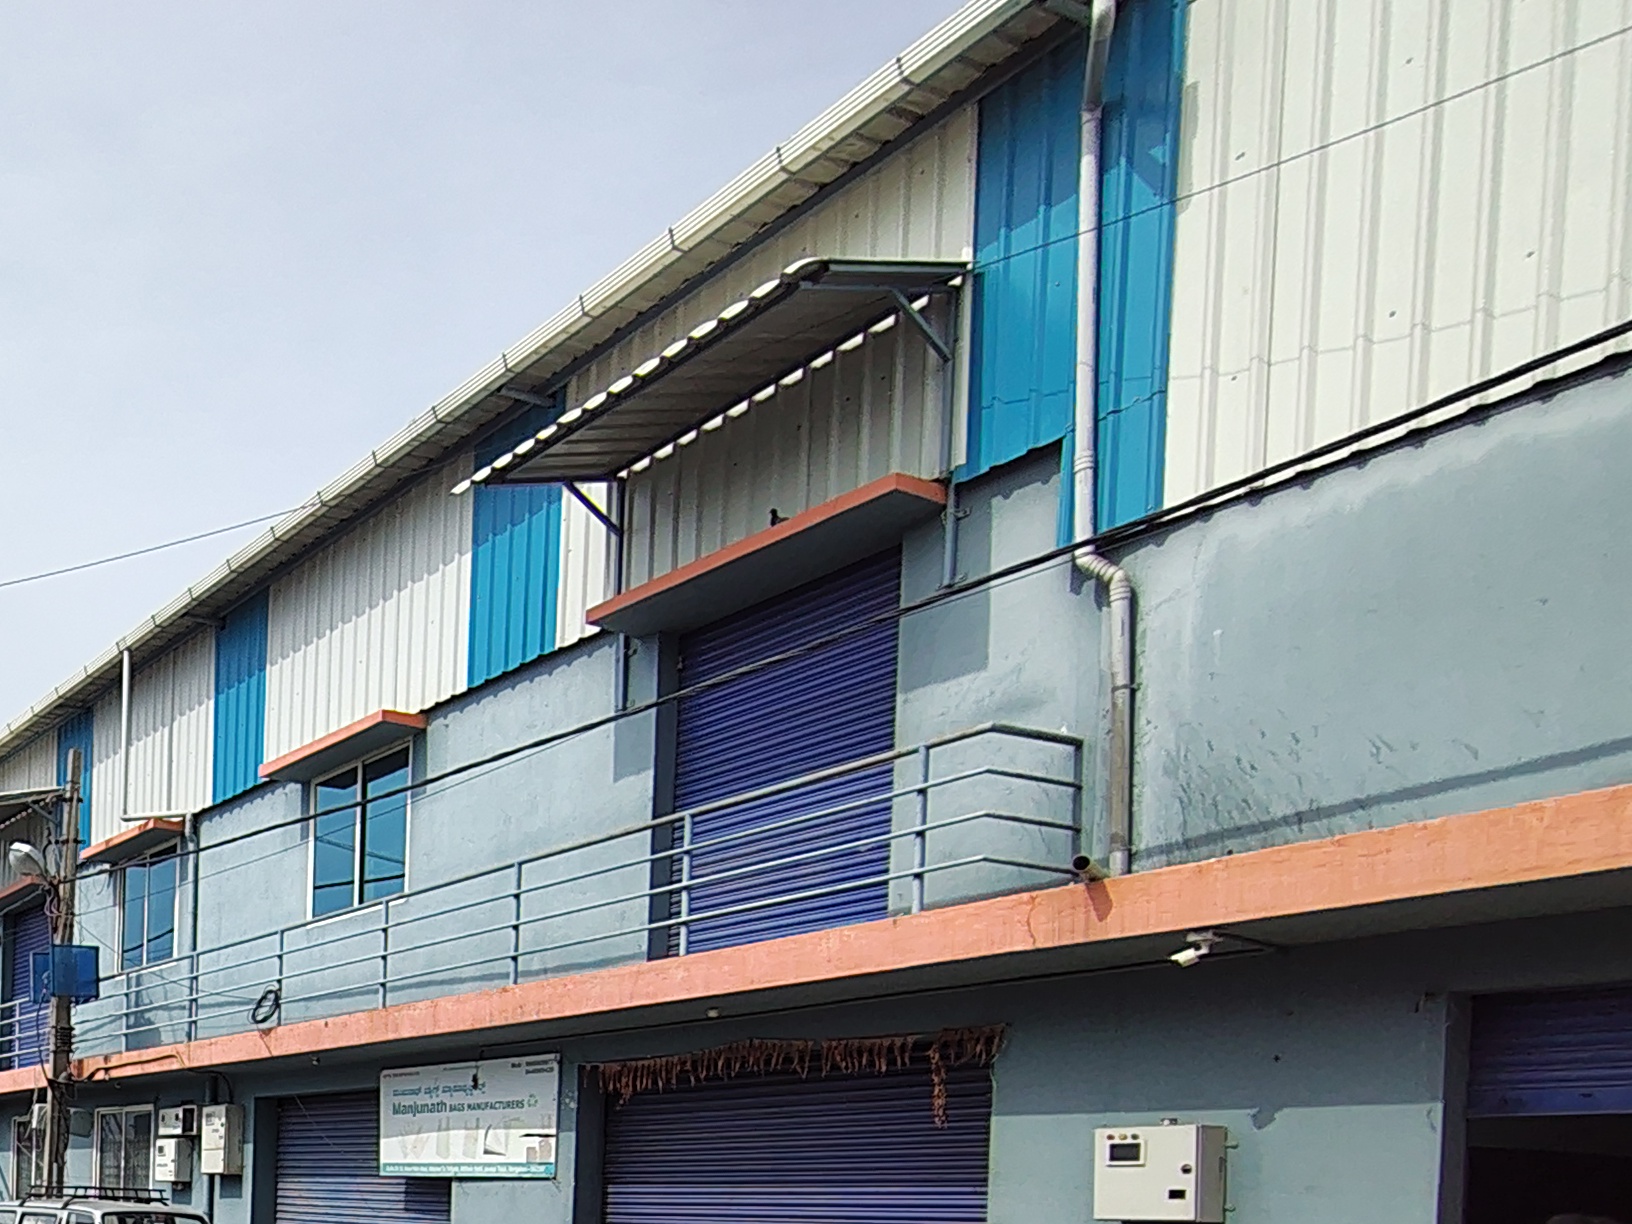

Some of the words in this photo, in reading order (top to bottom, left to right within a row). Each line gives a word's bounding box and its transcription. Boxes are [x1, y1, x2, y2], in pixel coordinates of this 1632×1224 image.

[392, 1099, 447, 1117] Manjunath
[449, 1102, 465, 1112] BAGS
[466, 1099, 525, 1111] MANUFACTURERS
